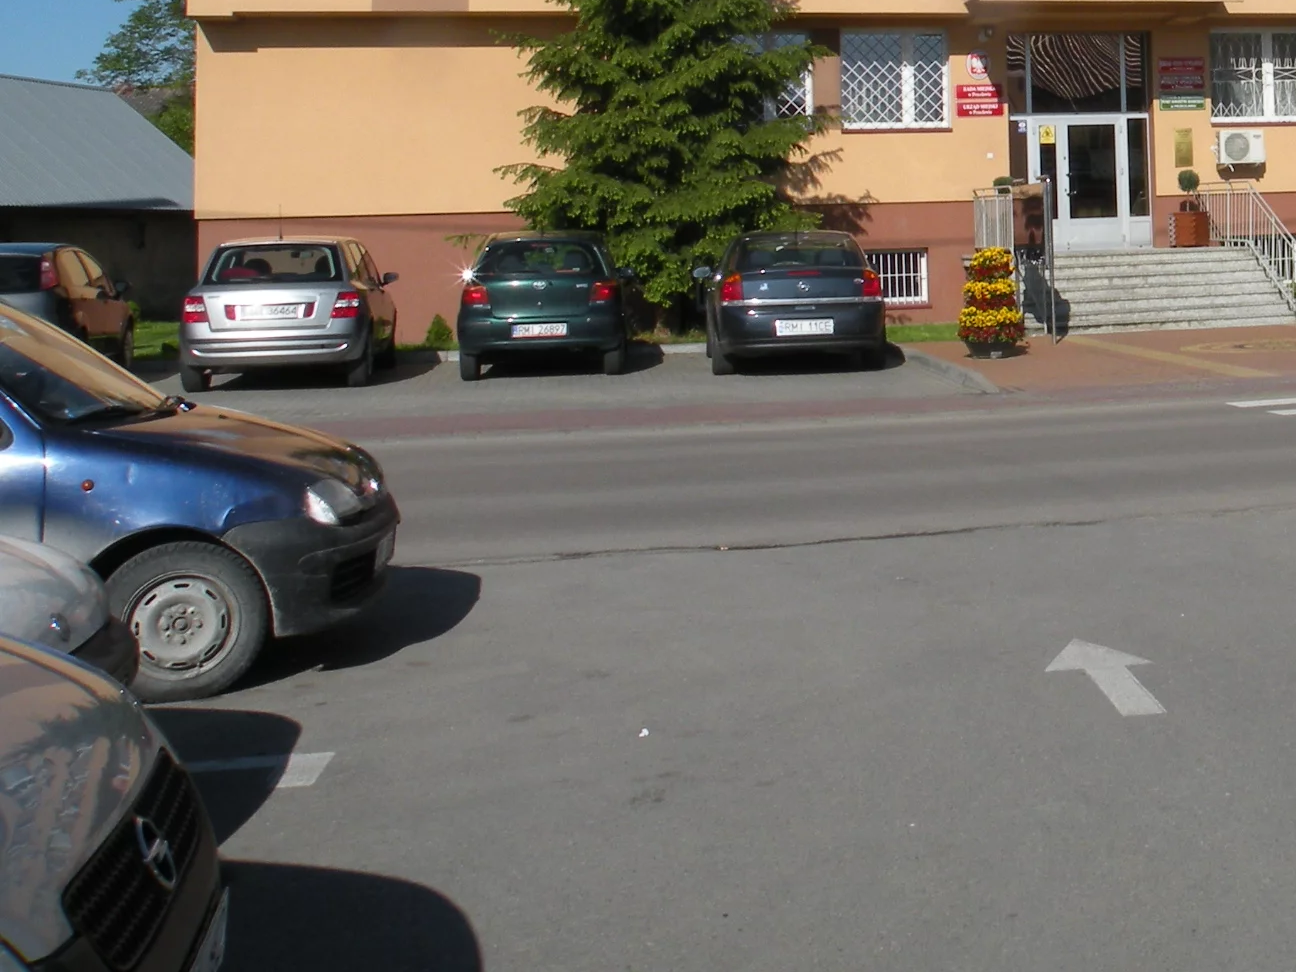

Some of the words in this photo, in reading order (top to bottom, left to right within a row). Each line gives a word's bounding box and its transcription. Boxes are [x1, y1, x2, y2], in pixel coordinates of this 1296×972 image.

[538, 324, 565, 335] 26897
[784, 322, 802, 331] RMI
[808, 321, 832, 331] 11CE
